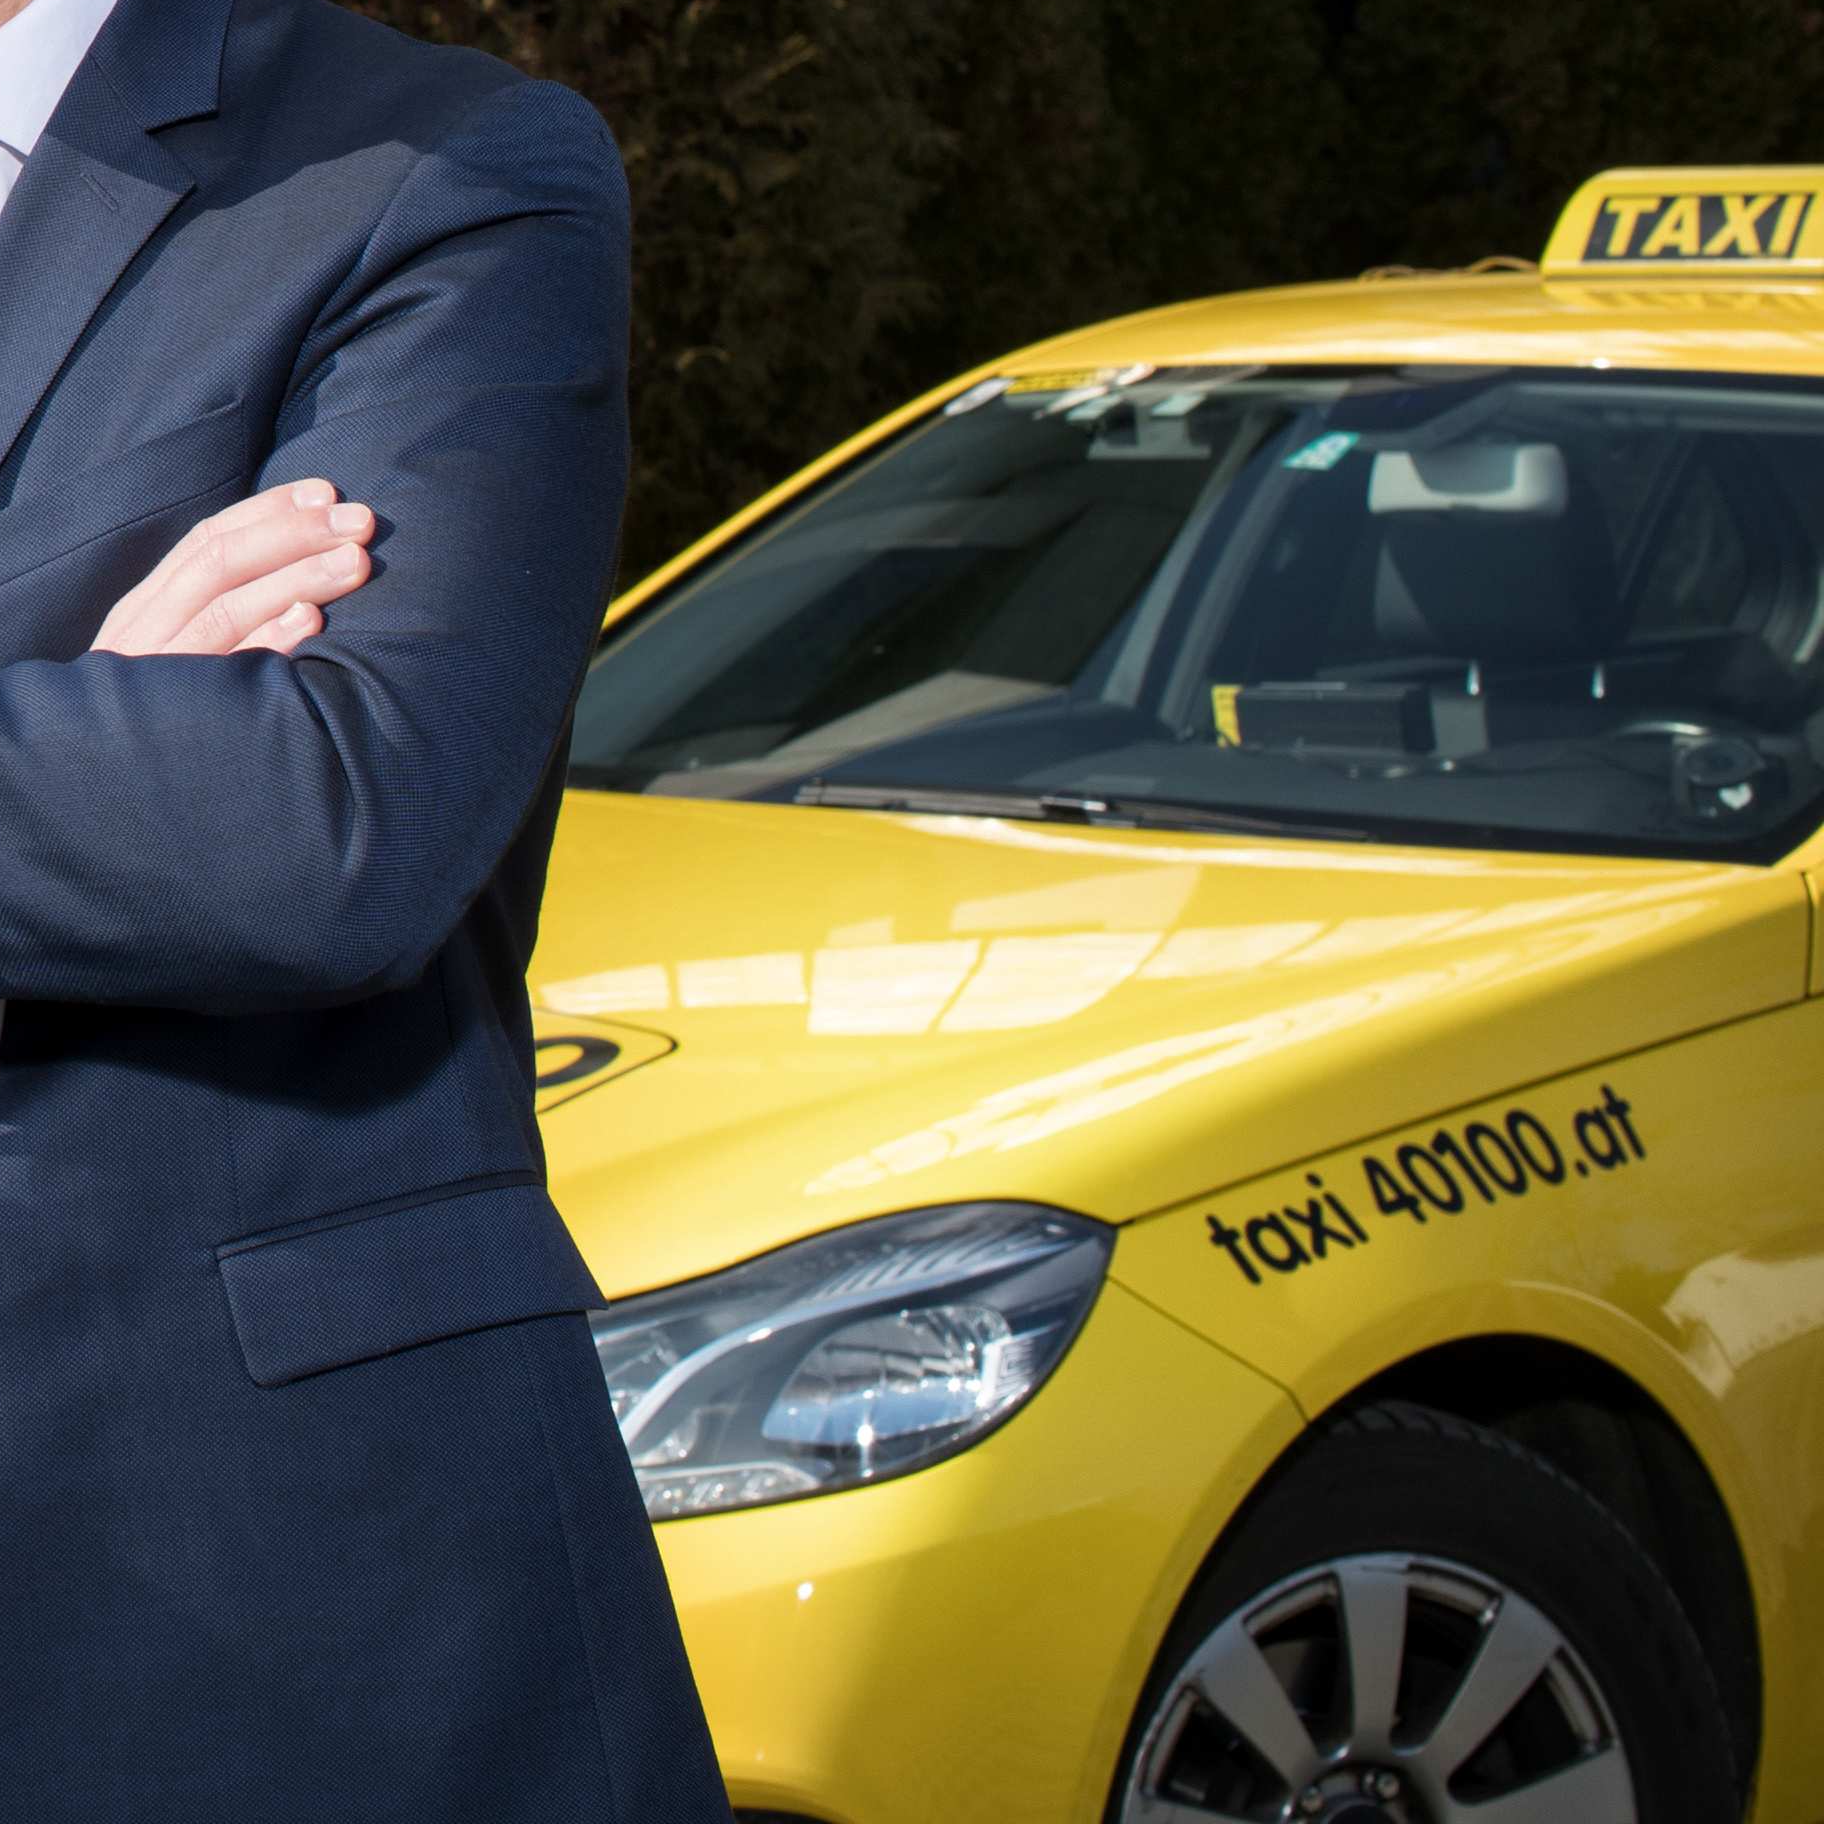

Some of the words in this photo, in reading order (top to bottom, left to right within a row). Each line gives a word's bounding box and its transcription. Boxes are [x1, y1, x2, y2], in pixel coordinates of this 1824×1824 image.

[1604, 192, 1809, 258] TAXI
[1205, 1171, 1370, 1285] taxi
[1361, 1082, 1648, 1225] 40100.at
